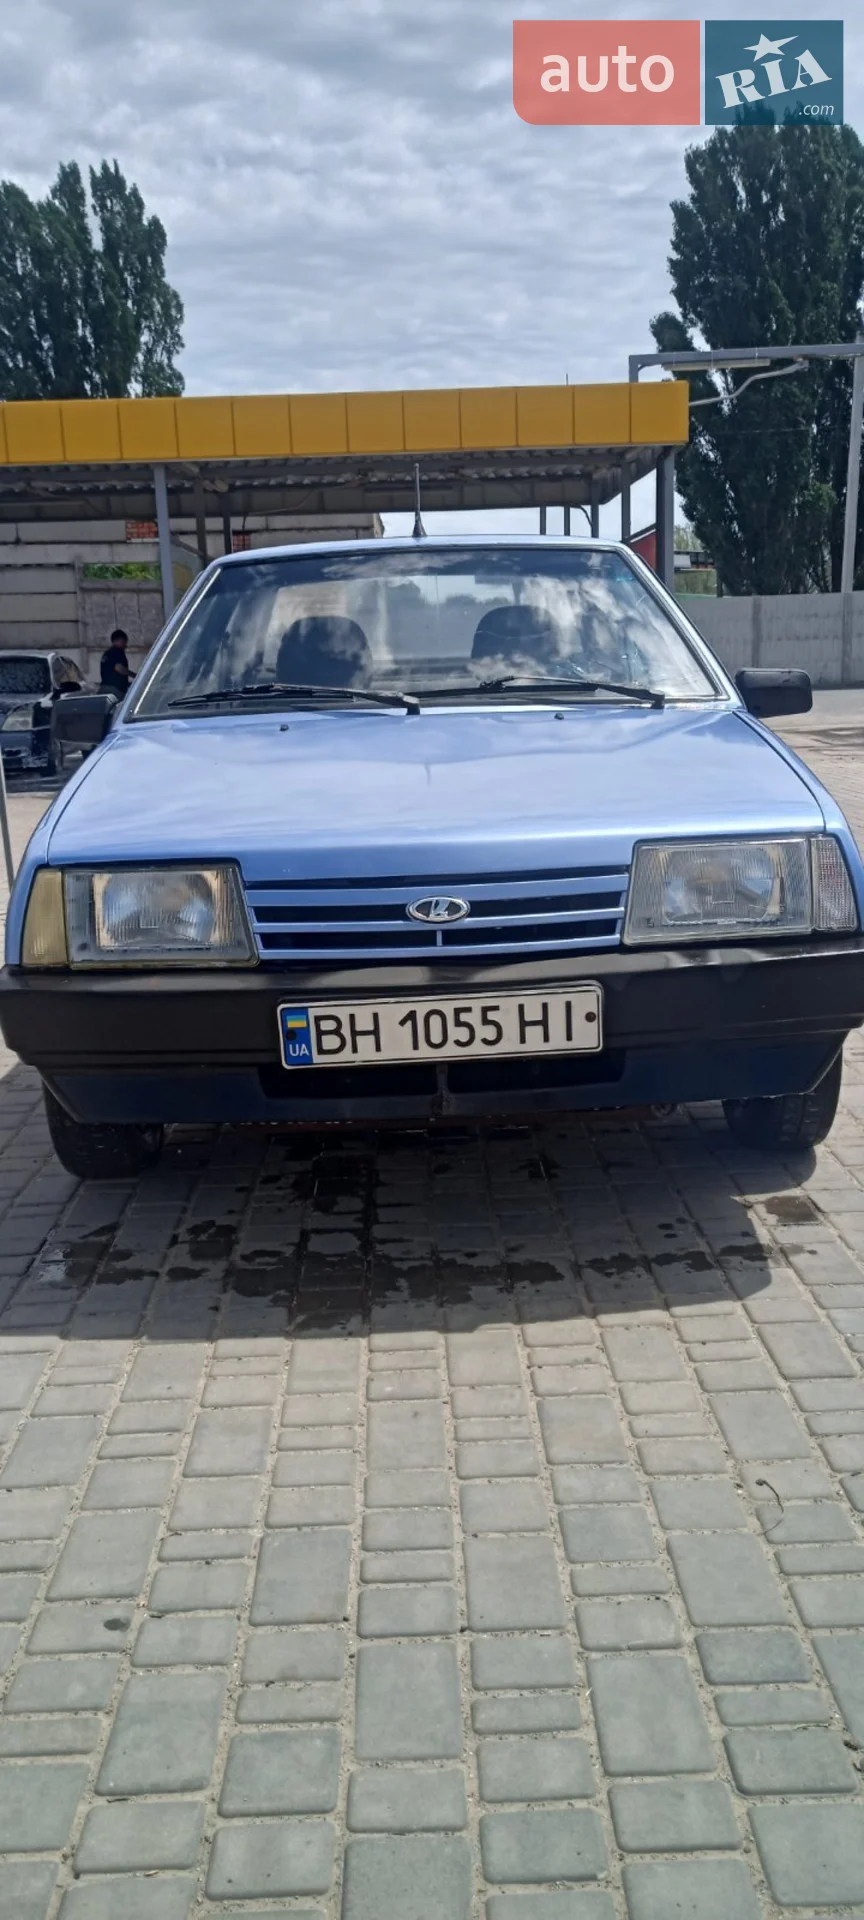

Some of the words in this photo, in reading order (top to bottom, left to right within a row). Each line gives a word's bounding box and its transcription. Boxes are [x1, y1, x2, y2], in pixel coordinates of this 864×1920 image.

[314, 1012, 381, 1056] BH
[398, 1005, 503, 1050] 1055
[518, 1000, 573, 1044] HI
[289, 1043, 310, 1057] UA
